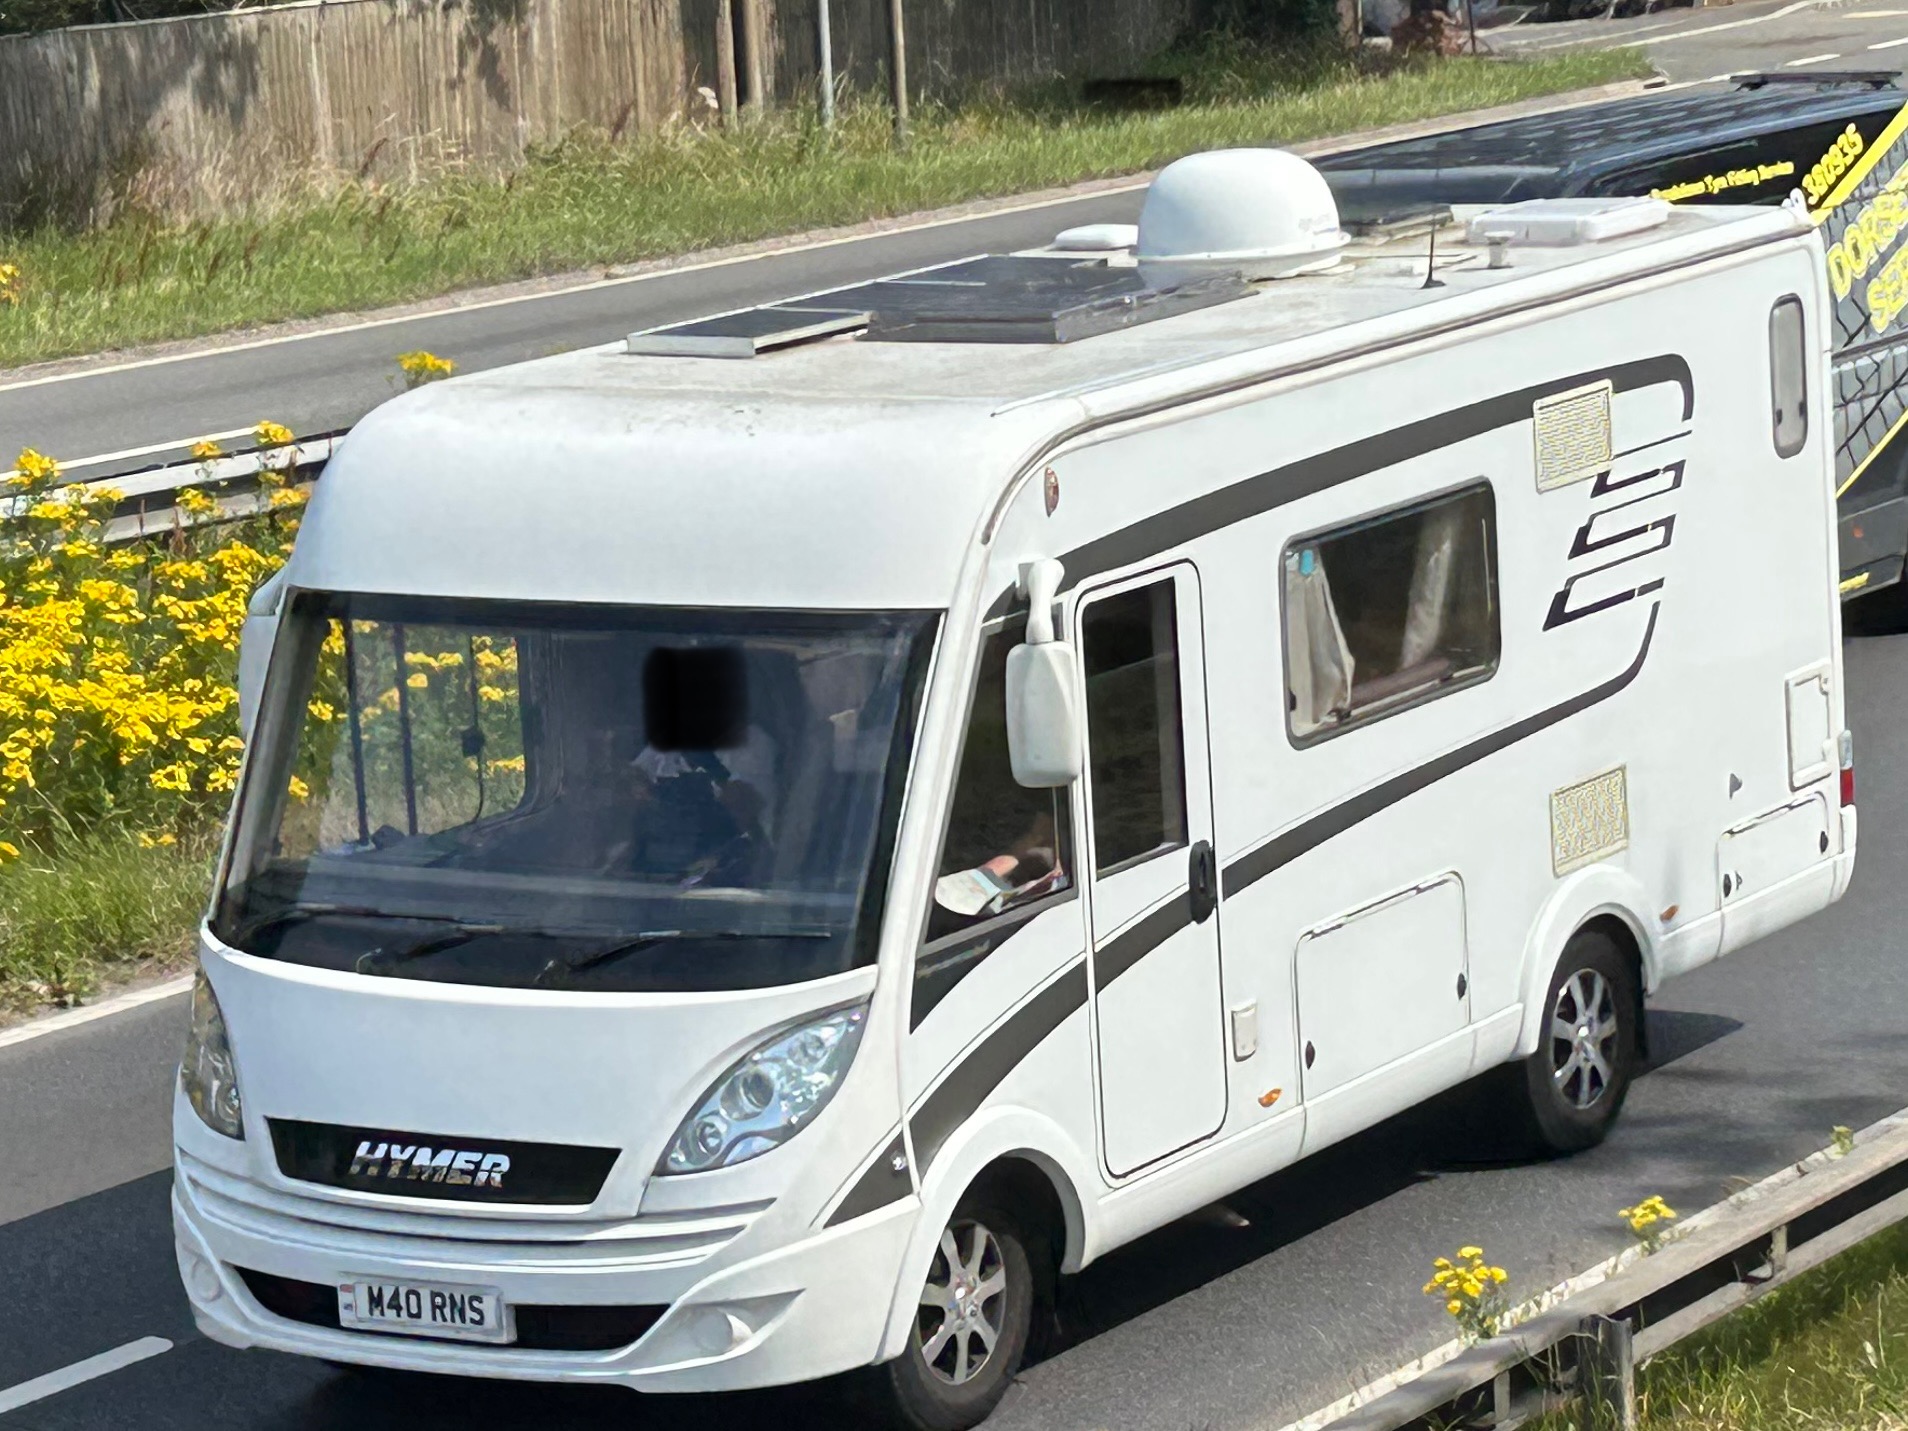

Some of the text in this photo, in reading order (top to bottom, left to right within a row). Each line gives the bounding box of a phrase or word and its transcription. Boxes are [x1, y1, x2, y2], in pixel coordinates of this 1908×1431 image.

[349, 1141, 511, 1188] HYMER
[367, 1285, 485, 1326] M40 RNS
